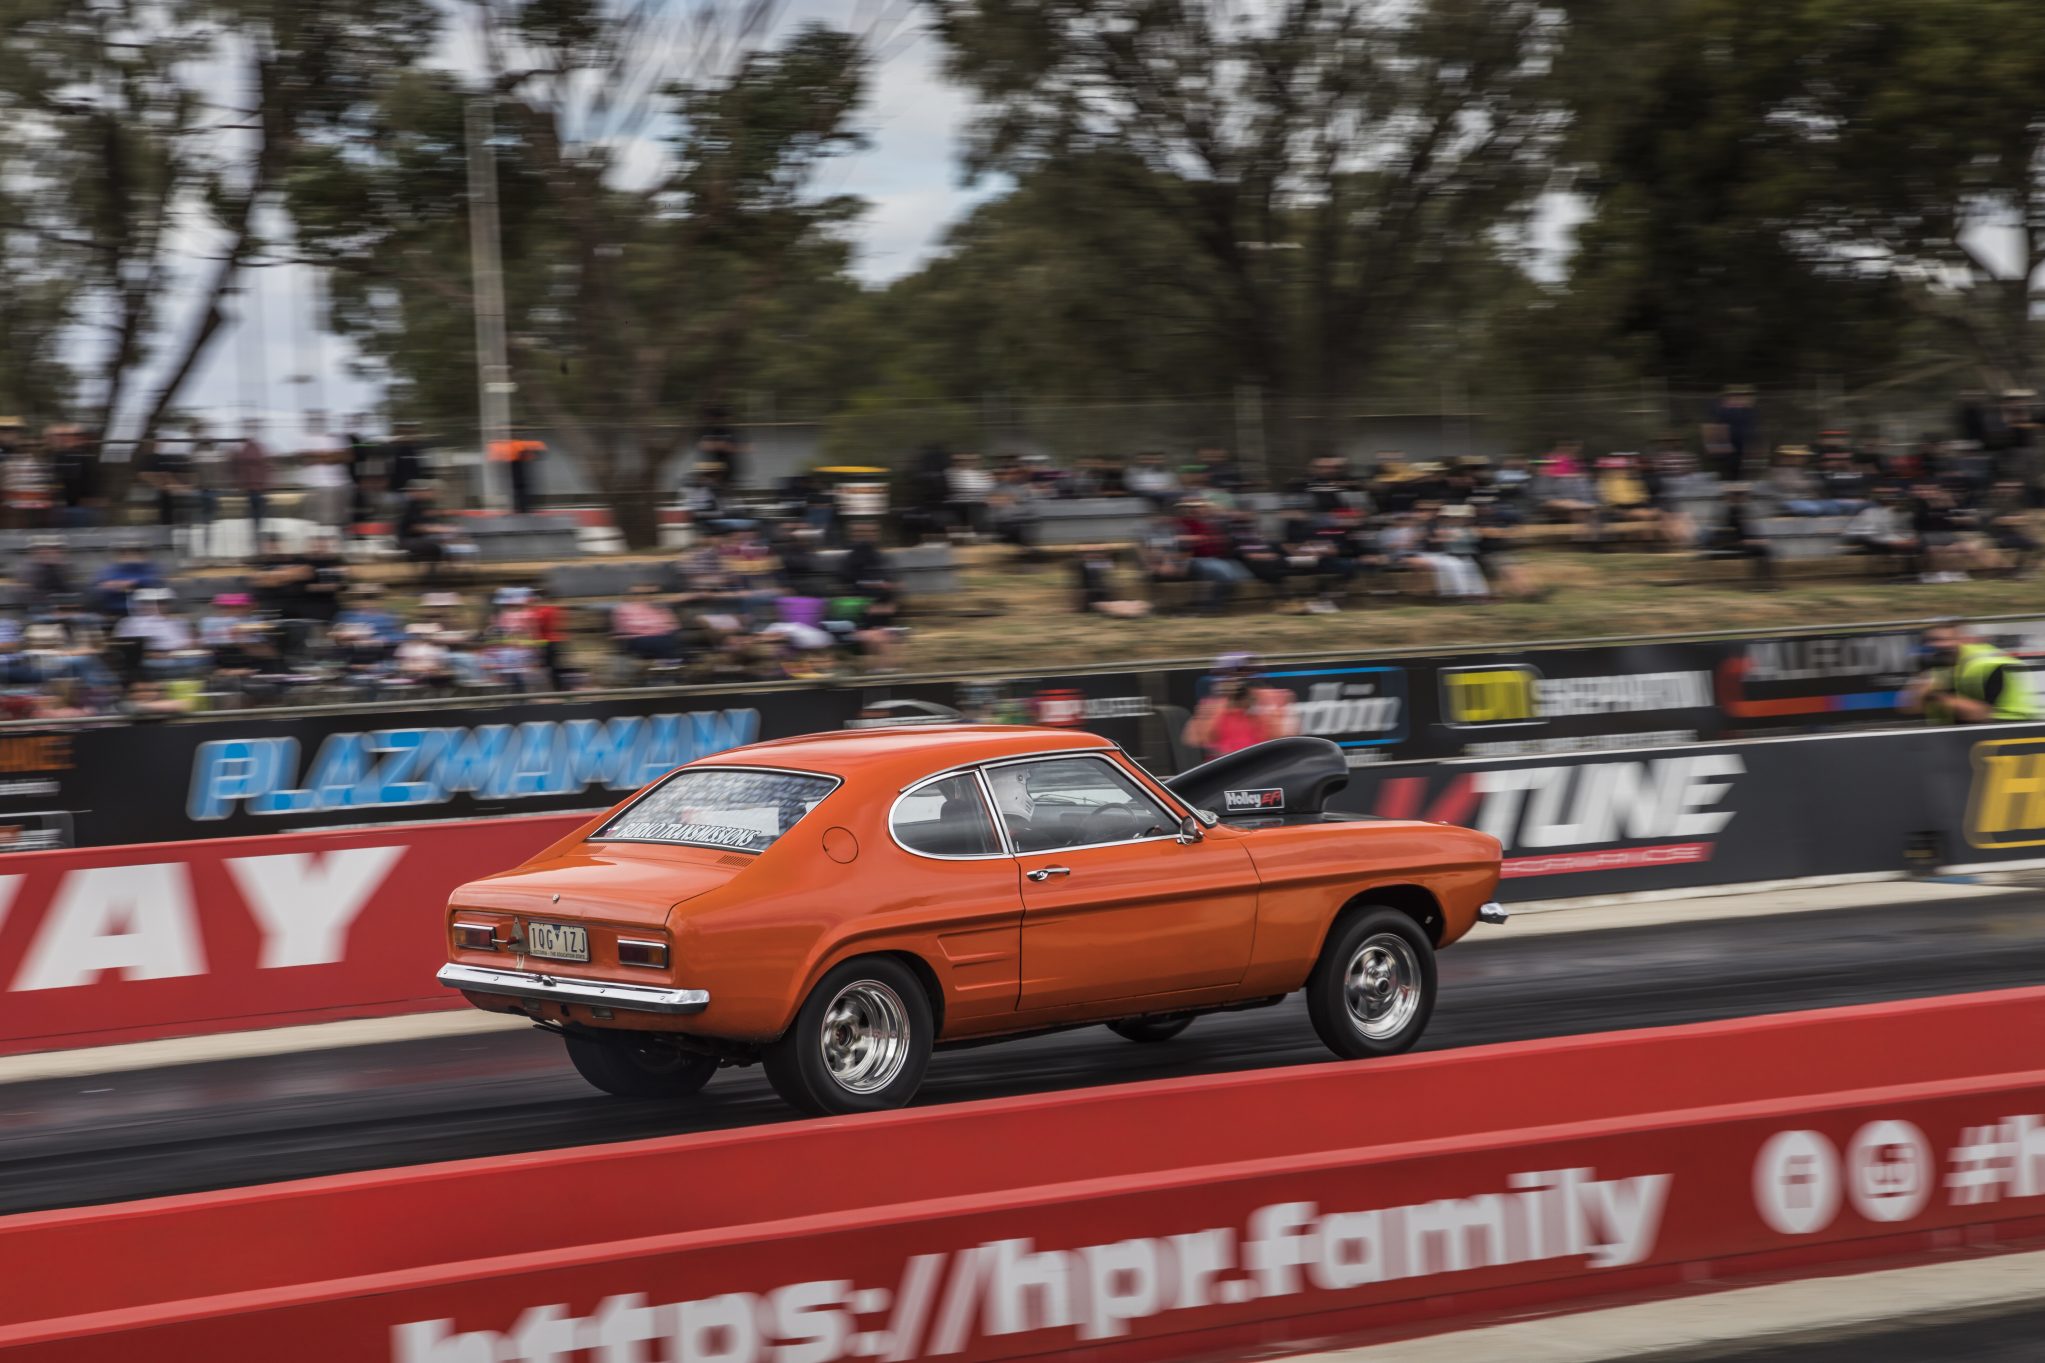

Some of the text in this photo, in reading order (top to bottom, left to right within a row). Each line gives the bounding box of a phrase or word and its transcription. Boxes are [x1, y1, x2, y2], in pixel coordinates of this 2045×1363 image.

[1226, 791, 1262, 808] Holley
[656, 823, 761, 846] TRANSMISSIONS
[0, 844, 413, 992] AY
